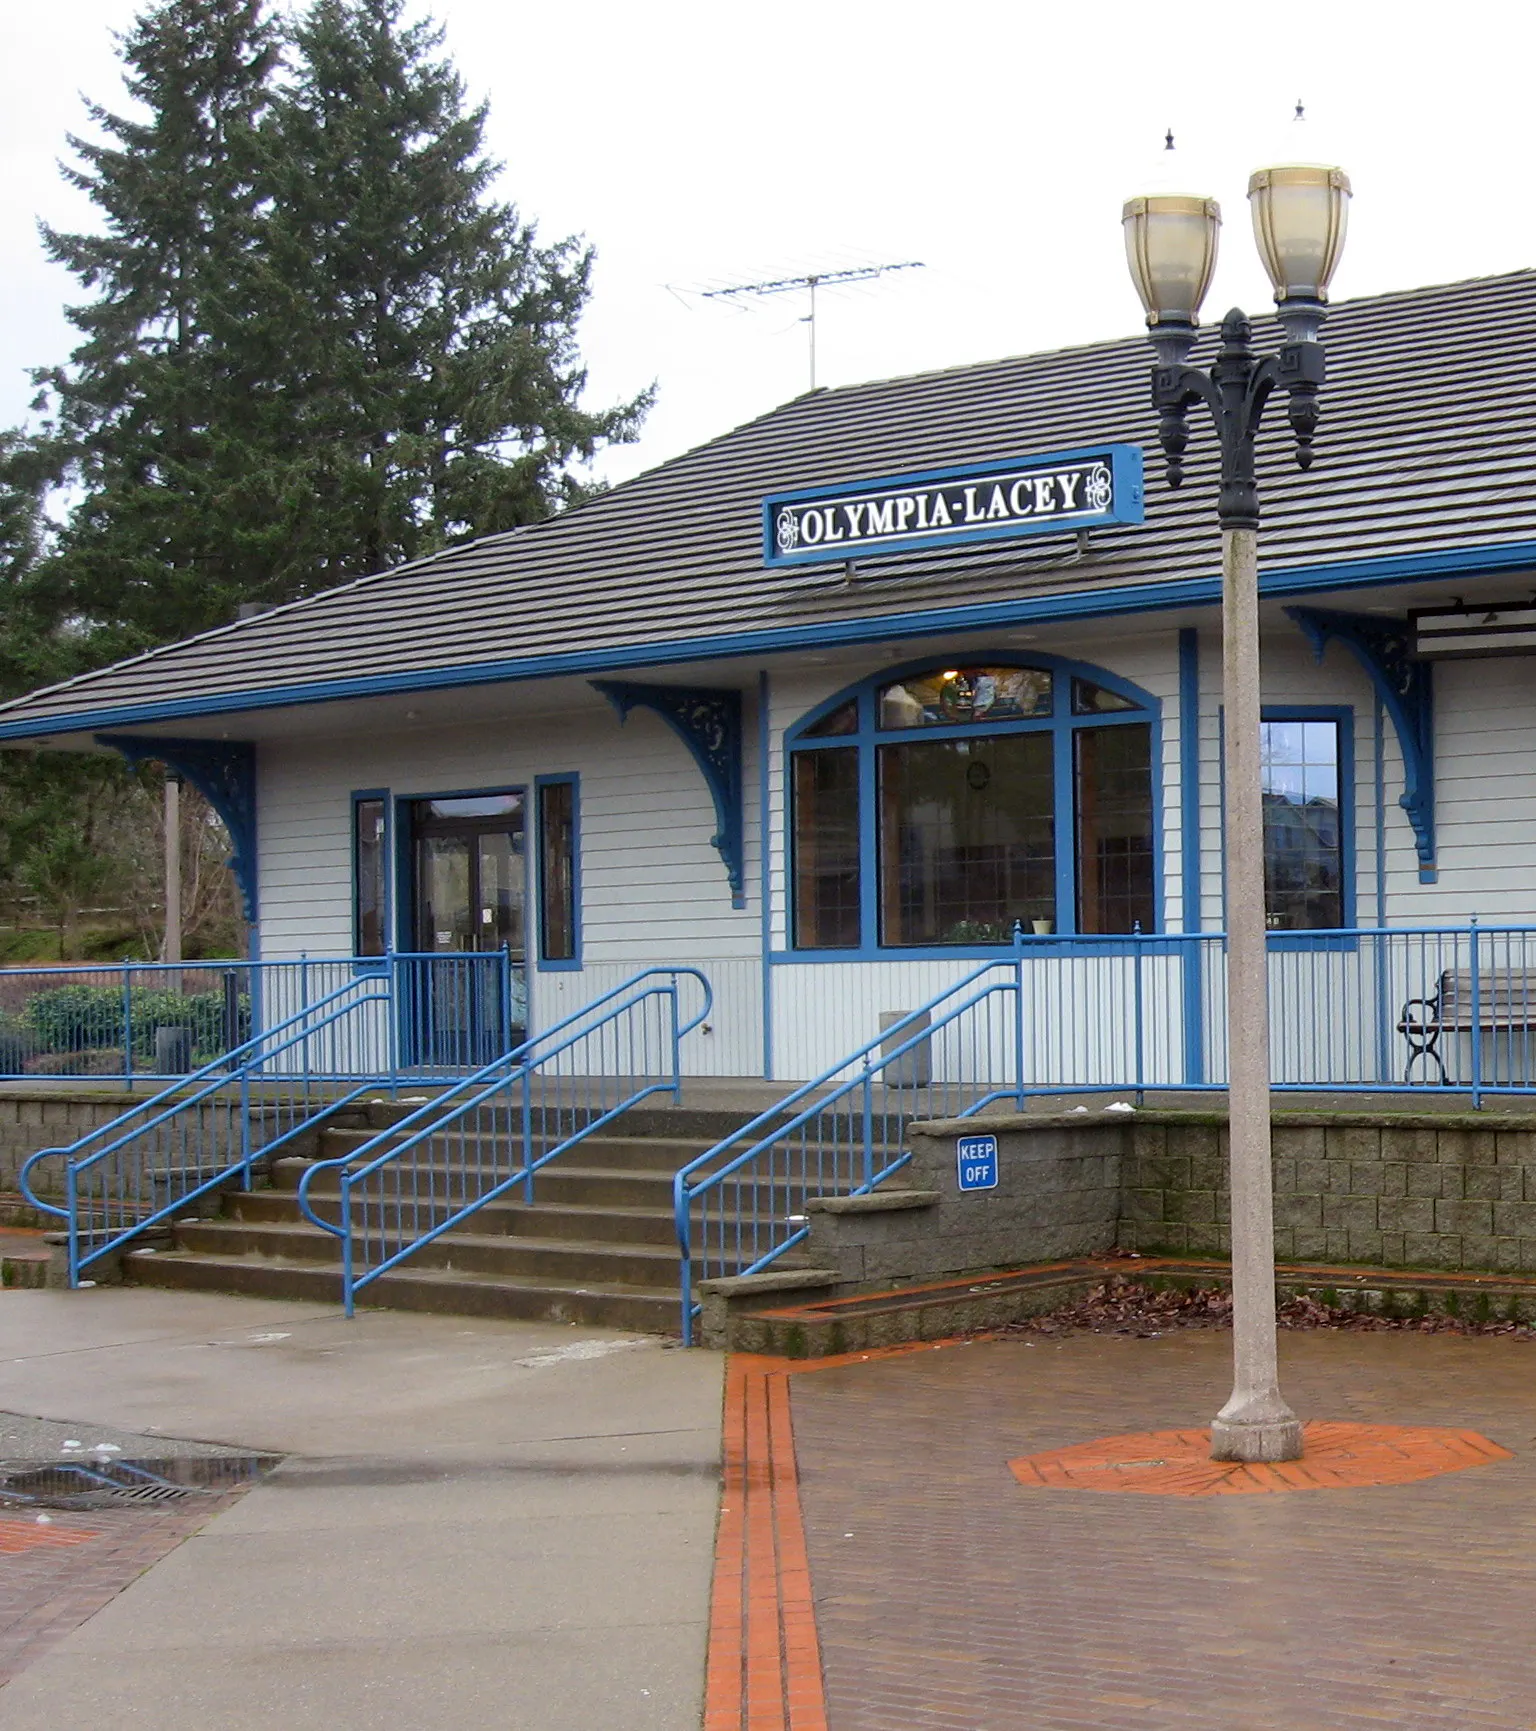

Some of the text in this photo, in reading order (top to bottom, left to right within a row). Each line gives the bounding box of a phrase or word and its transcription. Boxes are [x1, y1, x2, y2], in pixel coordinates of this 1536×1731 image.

[801, 472, 1081, 544] OLYMPIA-LACEY
[961, 1143, 994, 1160] KEEP
[966, 1165, 990, 1182] OFF
